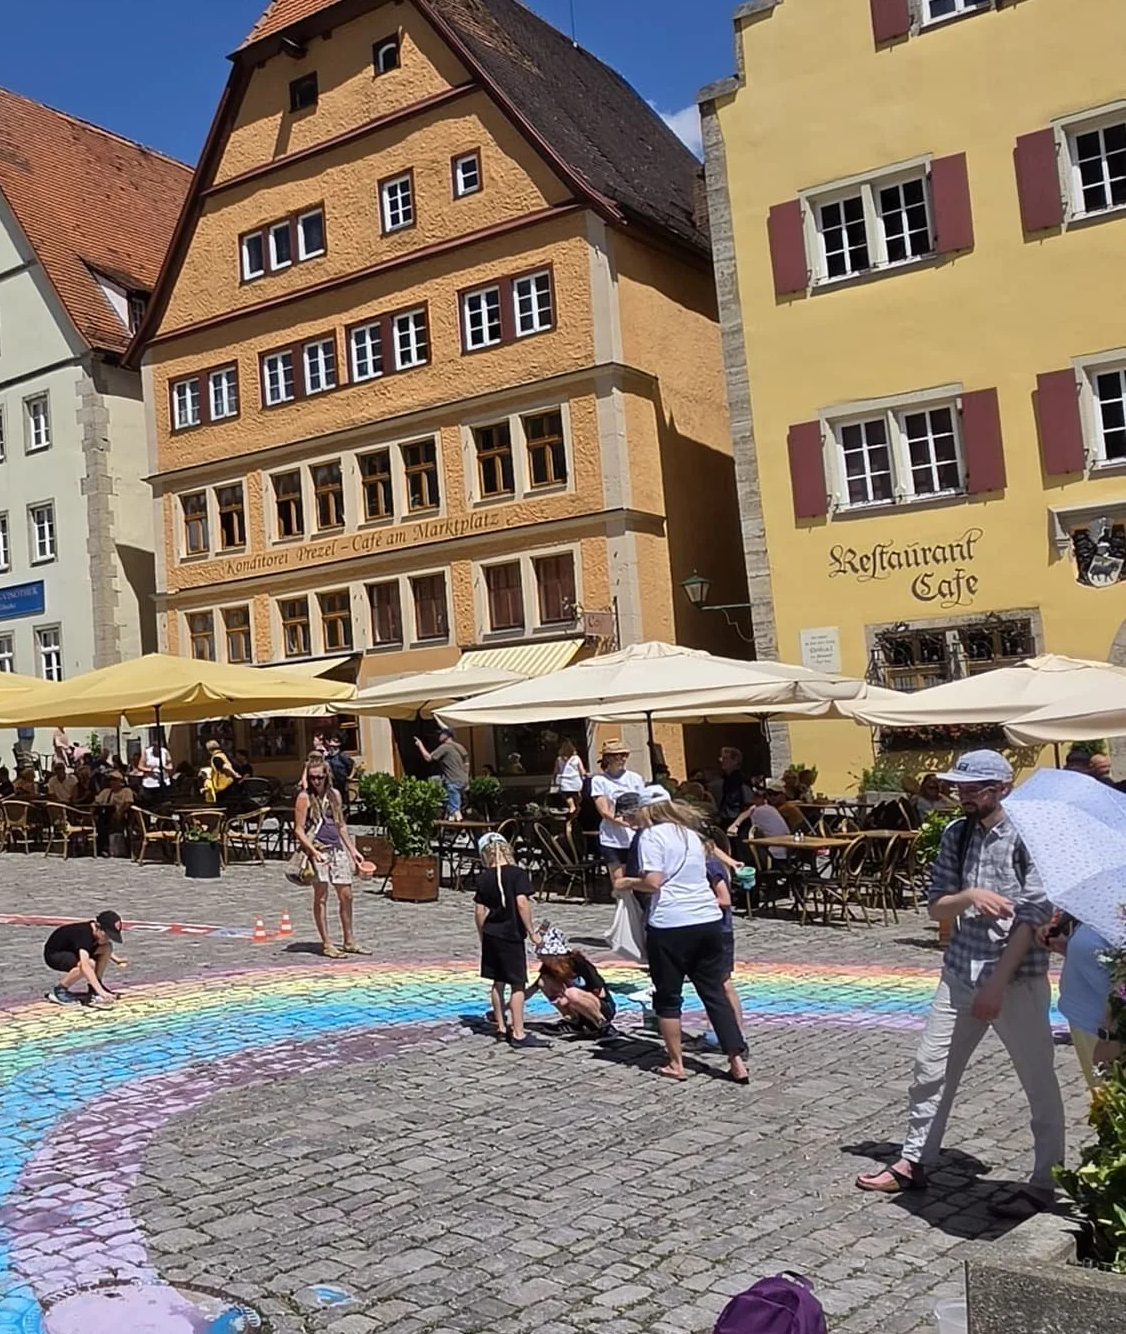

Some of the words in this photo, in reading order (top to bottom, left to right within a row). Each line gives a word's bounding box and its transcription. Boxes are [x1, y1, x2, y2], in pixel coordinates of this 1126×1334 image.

[226, 549, 289, 575] Konditorei
[296, 539, 339, 561] Prezel
[386, 531, 406, 546] am
[413, 513, 500, 542] Marktplatz
